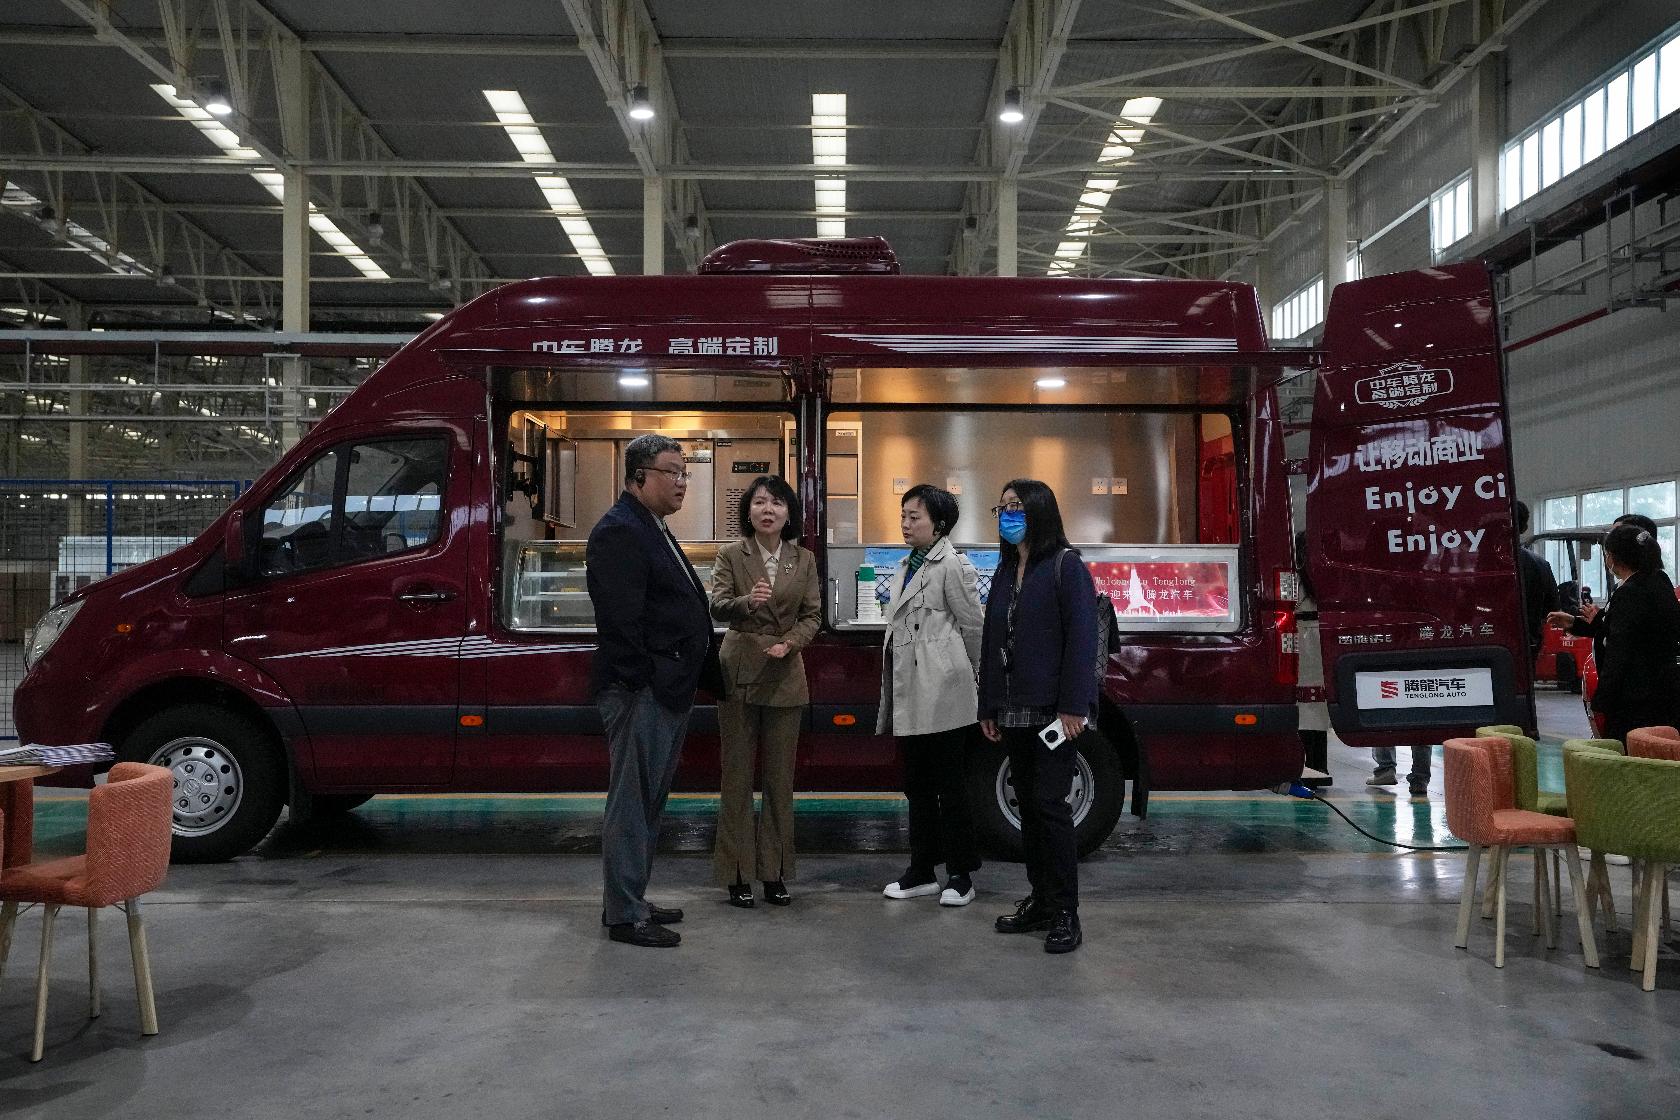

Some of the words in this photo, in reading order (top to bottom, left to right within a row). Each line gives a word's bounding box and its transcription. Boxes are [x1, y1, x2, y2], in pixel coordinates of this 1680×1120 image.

[668, 337, 778, 355] 高端定制
[1356, 434, 1485, 472] 让移动商业
[1365, 481, 1462, 513] Enjoy
[1474, 473, 1507, 500] Ci
[1387, 524, 1486, 555] Enjoy
[1152, 576, 1196, 587] Tenglong
[1098, 588, 1194, 600] 迎来腾龙汽车
